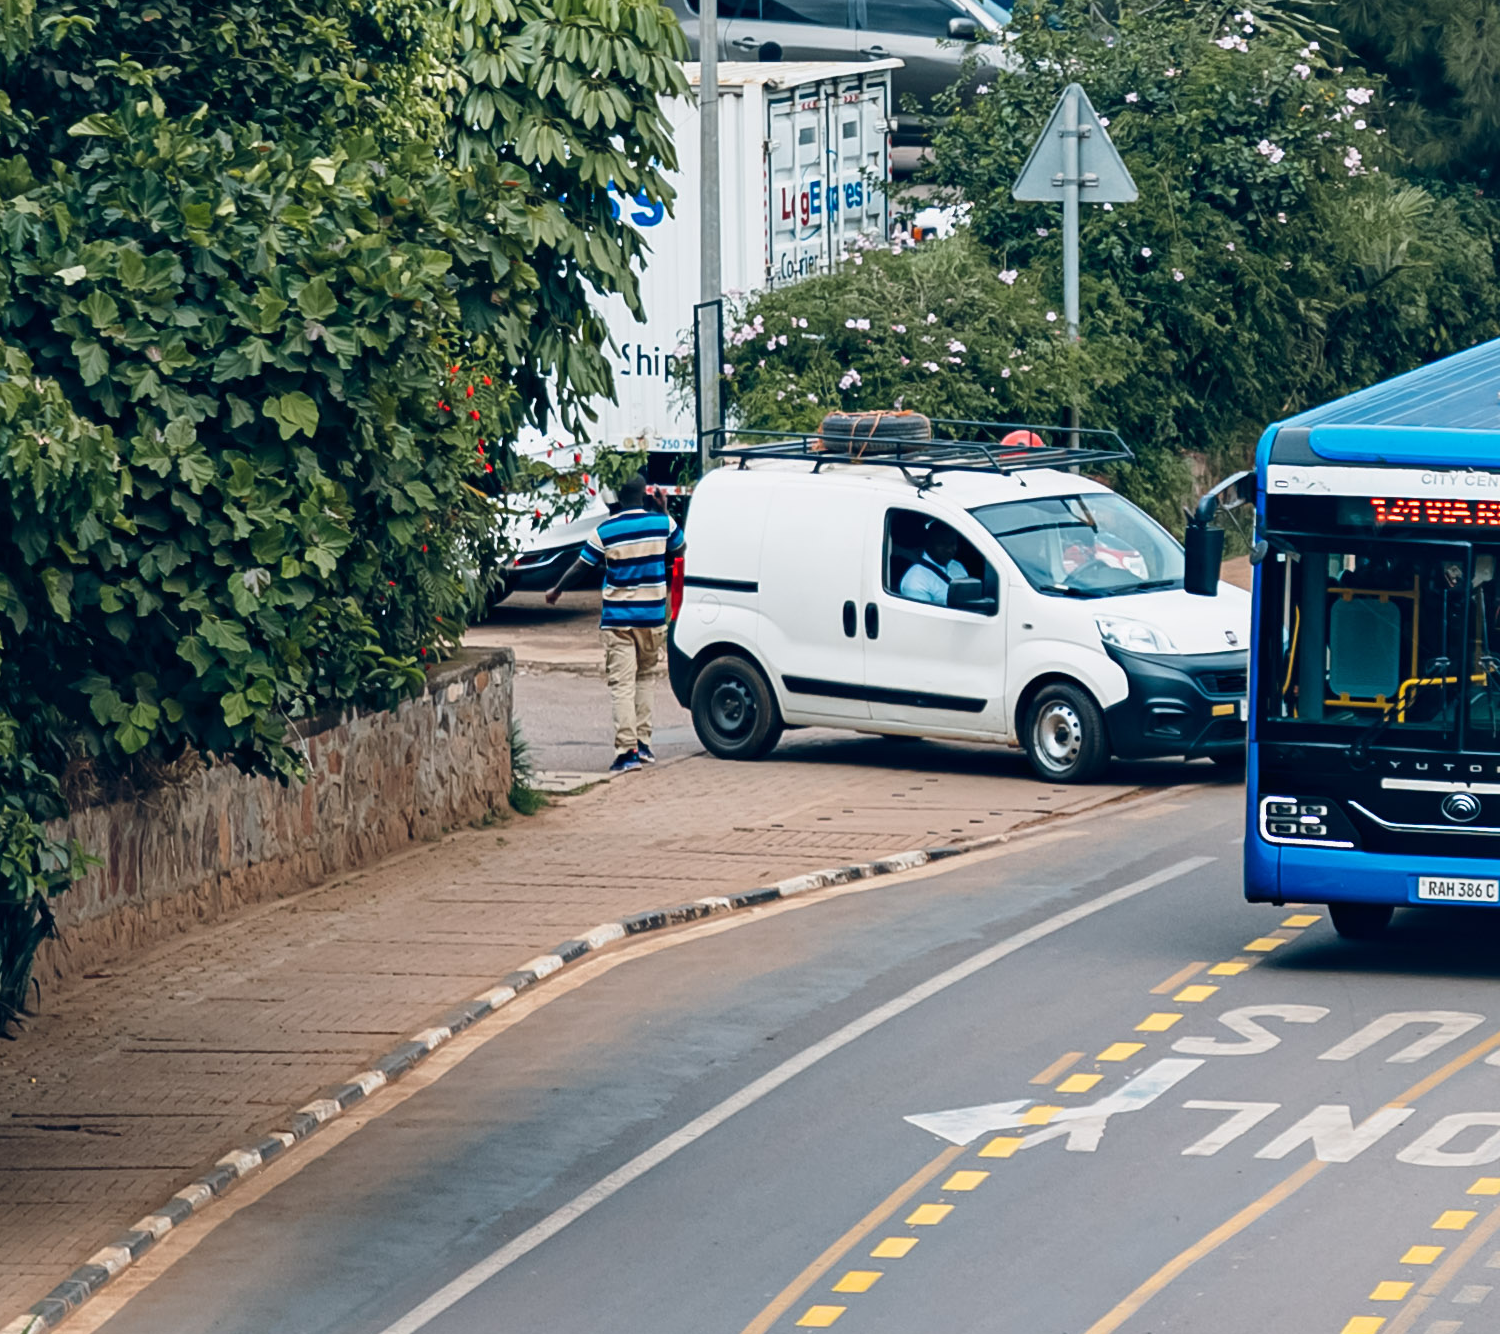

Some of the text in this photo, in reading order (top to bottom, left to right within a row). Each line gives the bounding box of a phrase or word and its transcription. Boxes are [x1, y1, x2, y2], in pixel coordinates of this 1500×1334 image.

[1421, 473, 1458, 485] CITY
[1428, 880, 1495, 899] RAH 386 C
